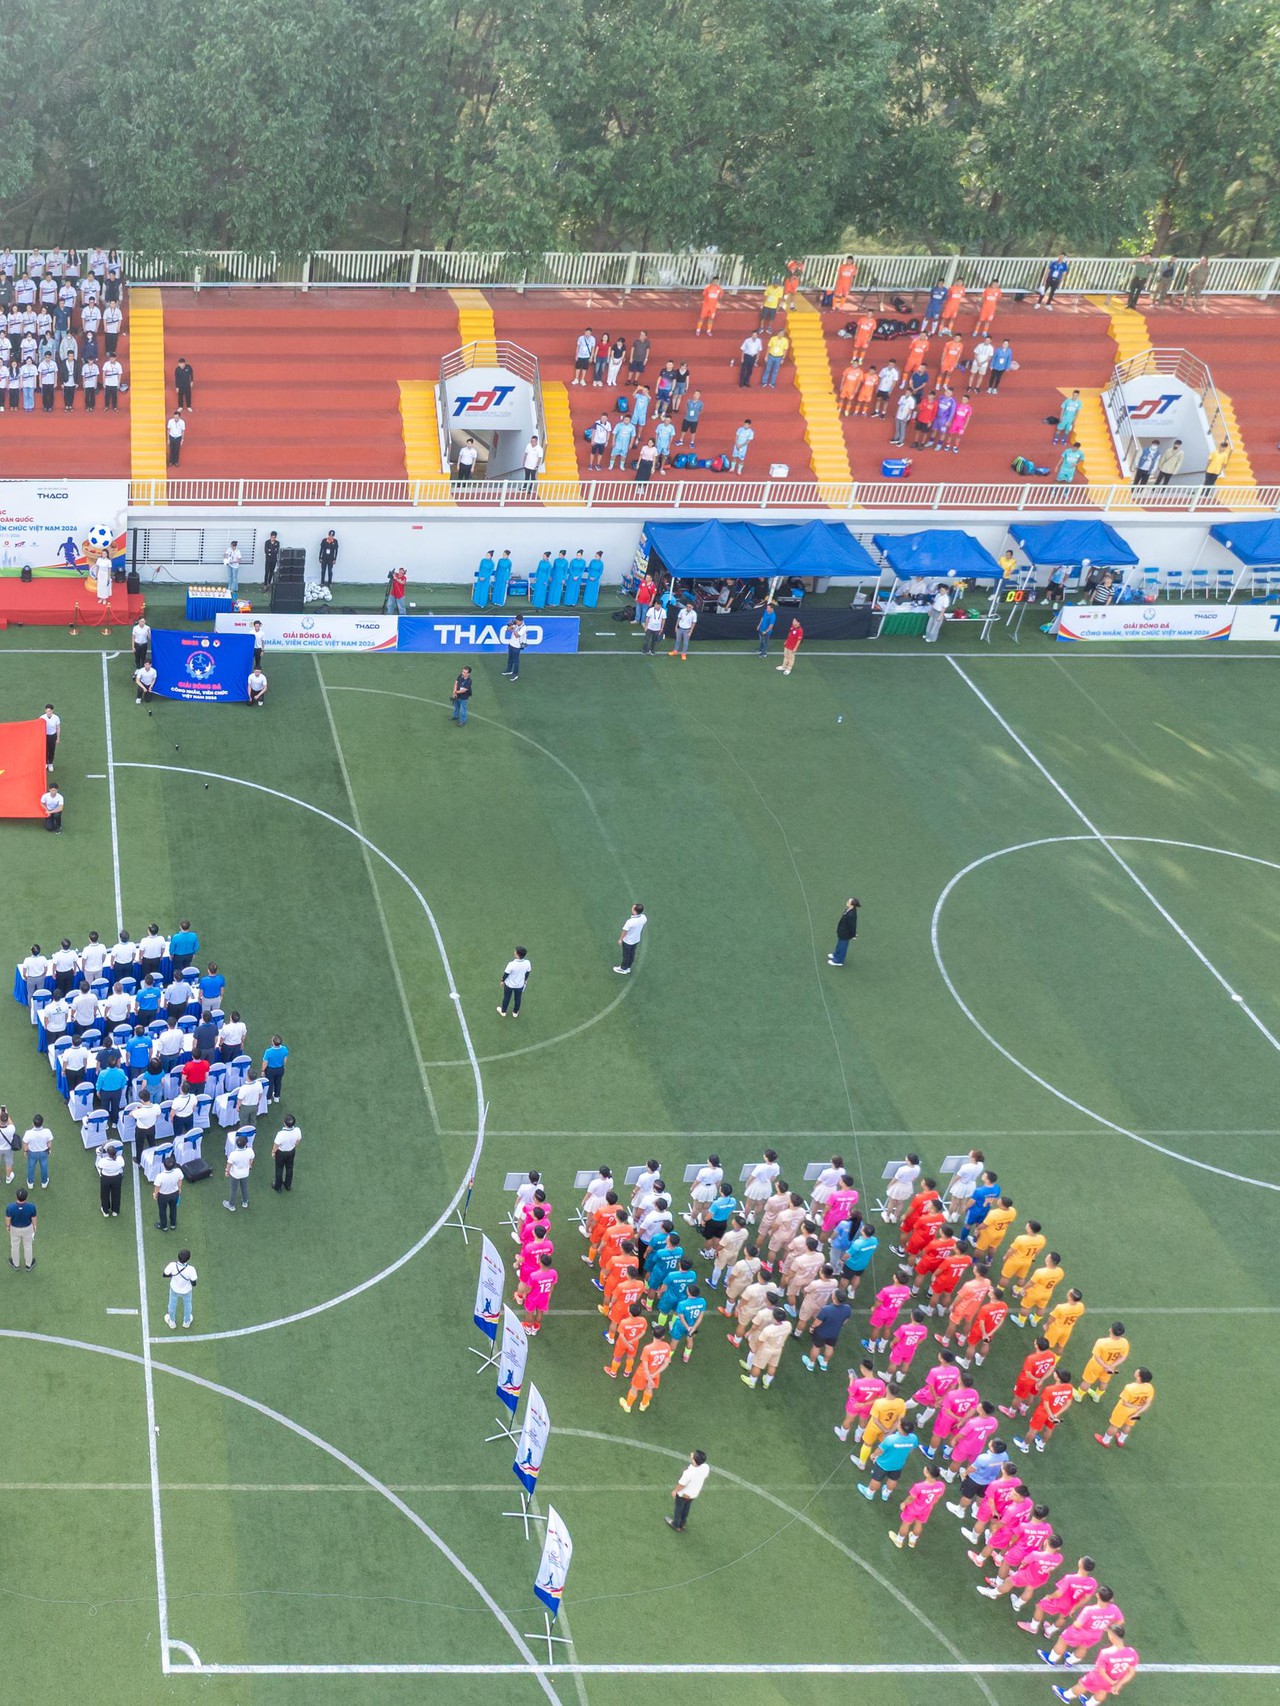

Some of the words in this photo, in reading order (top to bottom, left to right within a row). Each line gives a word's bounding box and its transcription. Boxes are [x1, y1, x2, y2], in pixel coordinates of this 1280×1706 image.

[452, 386, 516, 416] TDT
[29, 524, 44, 532] VIỆT
[1102, 629, 1123, 637] NHÂN,
[1163, 629, 1177, 637] VIỆT
[324, 639, 340, 648] VIỆT
[665, 1259, 677, 1269] 18
[539, 1283, 550, 1293] 12
[679, 1284, 686, 1293] 3
[1046, 1280, 1055, 1289] 6
[689, 1310, 700, 1319] 19
[1063, 1316, 1075, 1325] 15
[630, 1328, 637, 1337] 3
[865, 1391, 873, 1400] 7
[958, 1402, 971, 1413] 13
[925, 1493, 934, 1504] 3
[1027, 1535, 1044, 1547] 27
